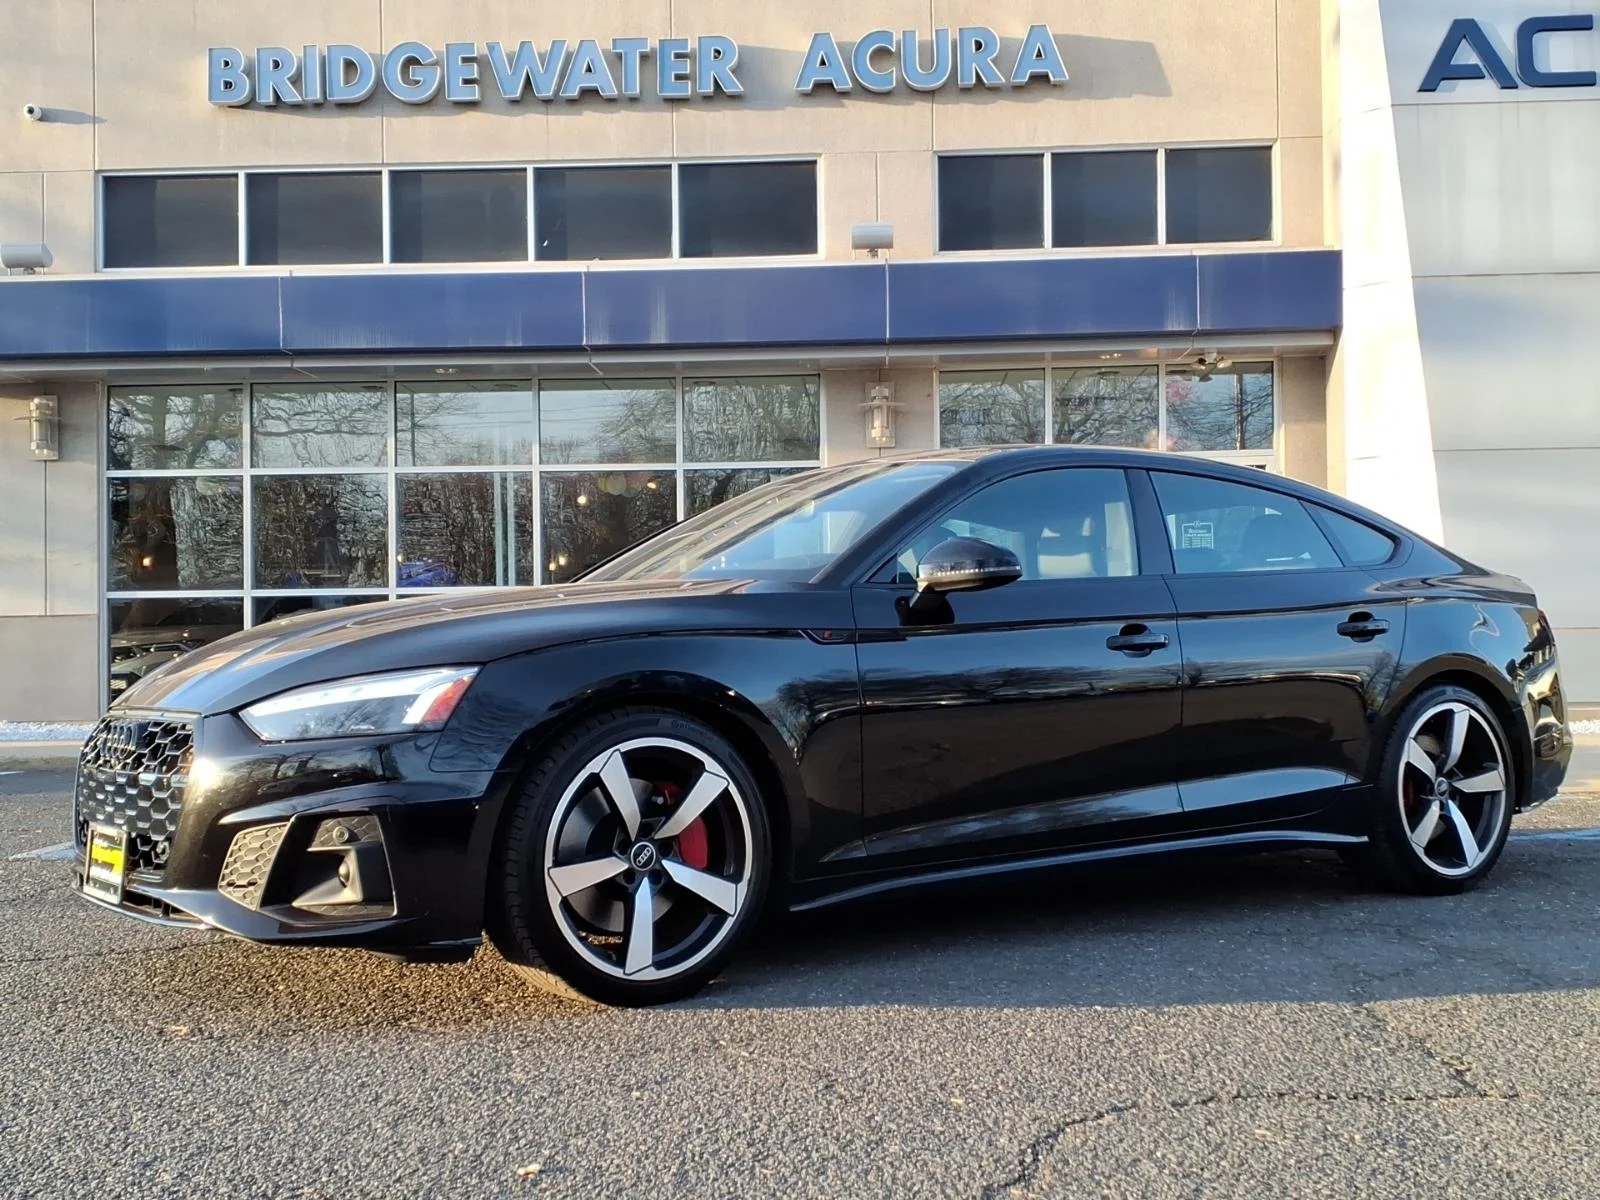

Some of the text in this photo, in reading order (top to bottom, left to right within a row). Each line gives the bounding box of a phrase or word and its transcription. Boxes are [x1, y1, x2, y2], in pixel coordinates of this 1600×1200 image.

[208, 24, 1070, 106] BRIDGEWATER ACURA
[1417, 14, 1597, 92] AC
